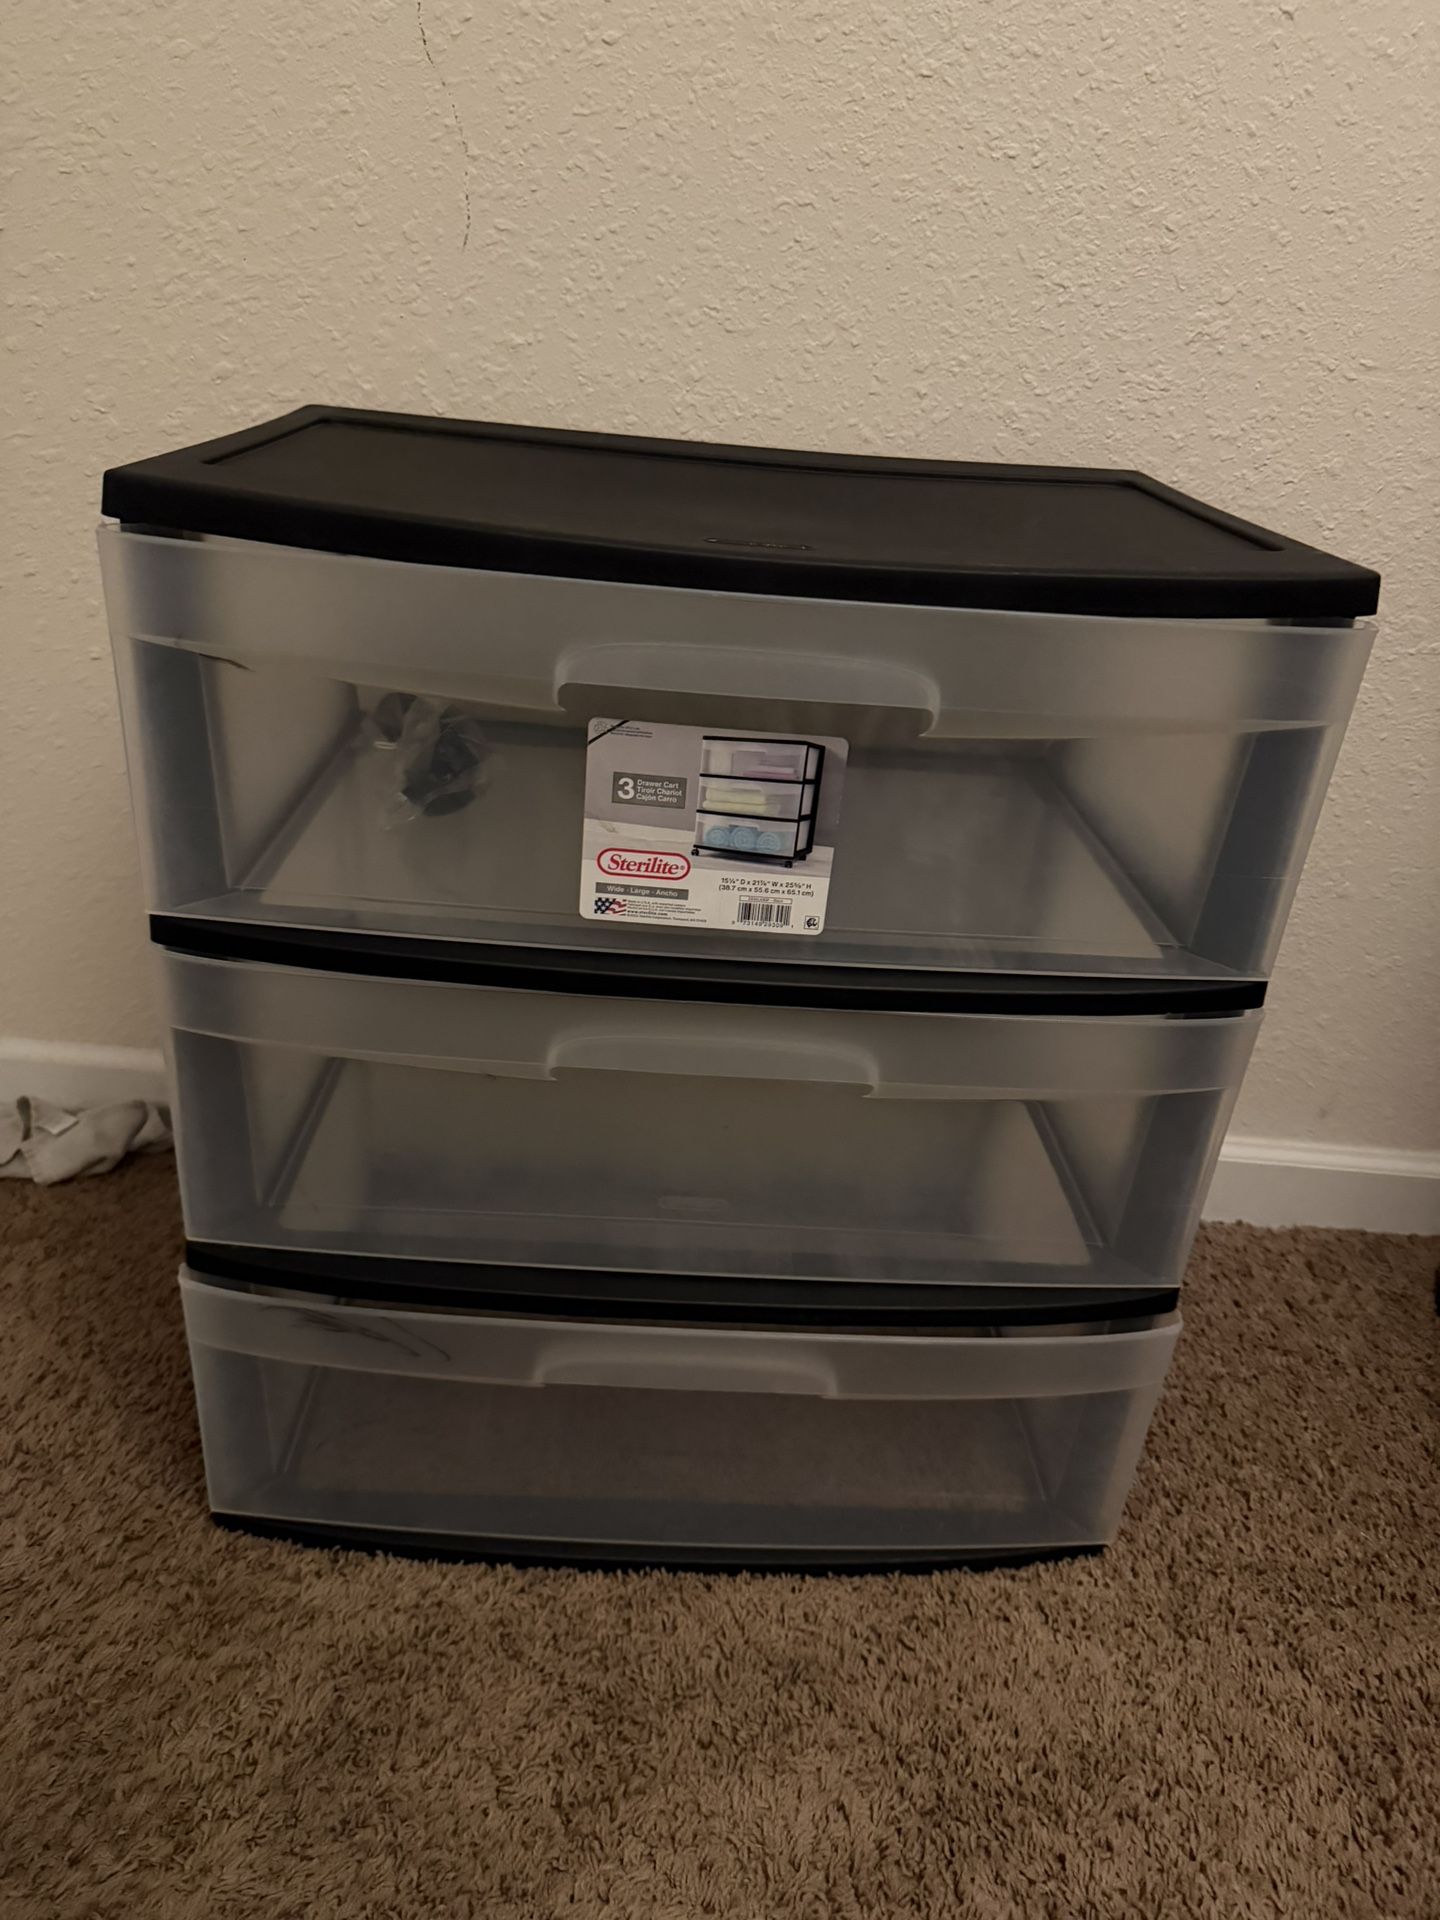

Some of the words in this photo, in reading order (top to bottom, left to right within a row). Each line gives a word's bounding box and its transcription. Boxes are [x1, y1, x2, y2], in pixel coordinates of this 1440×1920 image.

[617, 777, 635, 799] 3
[637, 779, 662, 787] Drawer
[663, 781, 679, 789] Cart
[637, 786, 655, 794] Tiroir
[656, 788, 682, 796] Chariot
[657, 795, 678, 803] Carro
[607, 853, 680, 875] Sterilite
[607, 885, 624, 893] Wide
[630, 887, 650, 895] Large
